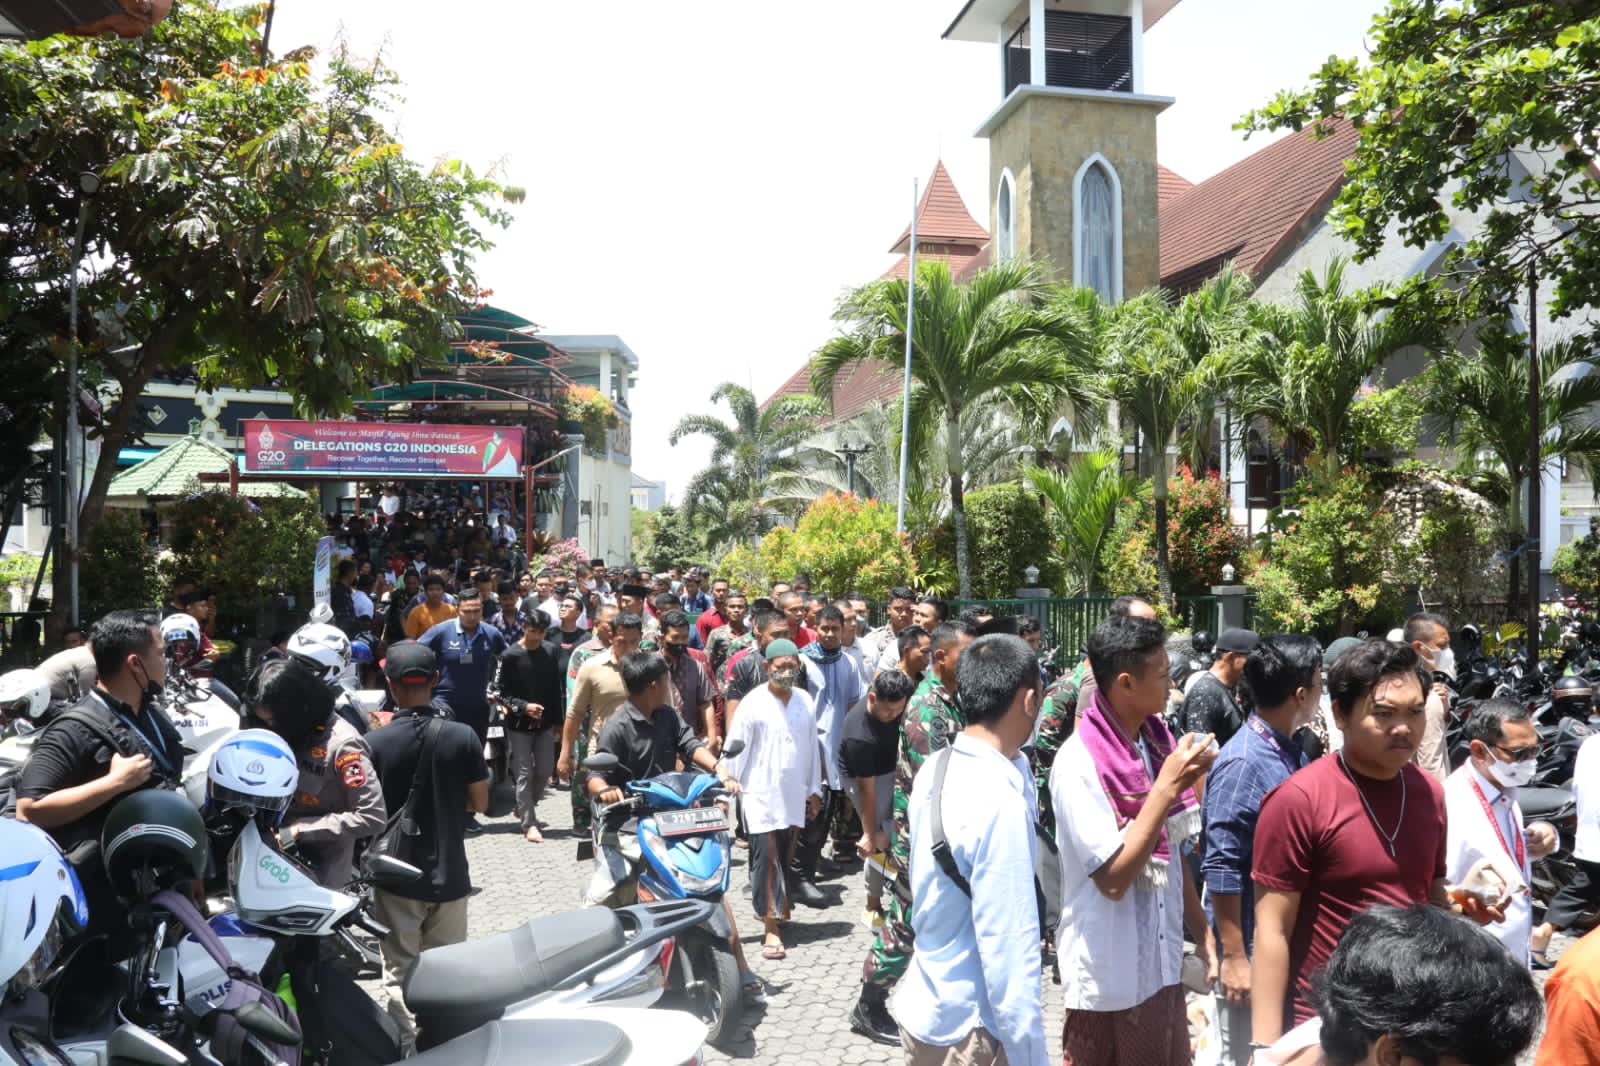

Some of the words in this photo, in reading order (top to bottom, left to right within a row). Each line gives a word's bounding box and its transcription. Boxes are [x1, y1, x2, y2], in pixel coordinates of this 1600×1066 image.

[293, 440, 382, 452] DELEGATIONS
[383, 442, 408, 453] G20
[410, 443, 477, 455] INDONESIA
[257, 450, 286, 462] G20
[327, 454, 356, 462] Recover
[357, 455, 386, 464] Together,
[418, 457, 446, 465] Stronger
[175, 719, 208, 727] POLISI
[259, 854, 290, 884] Grab
